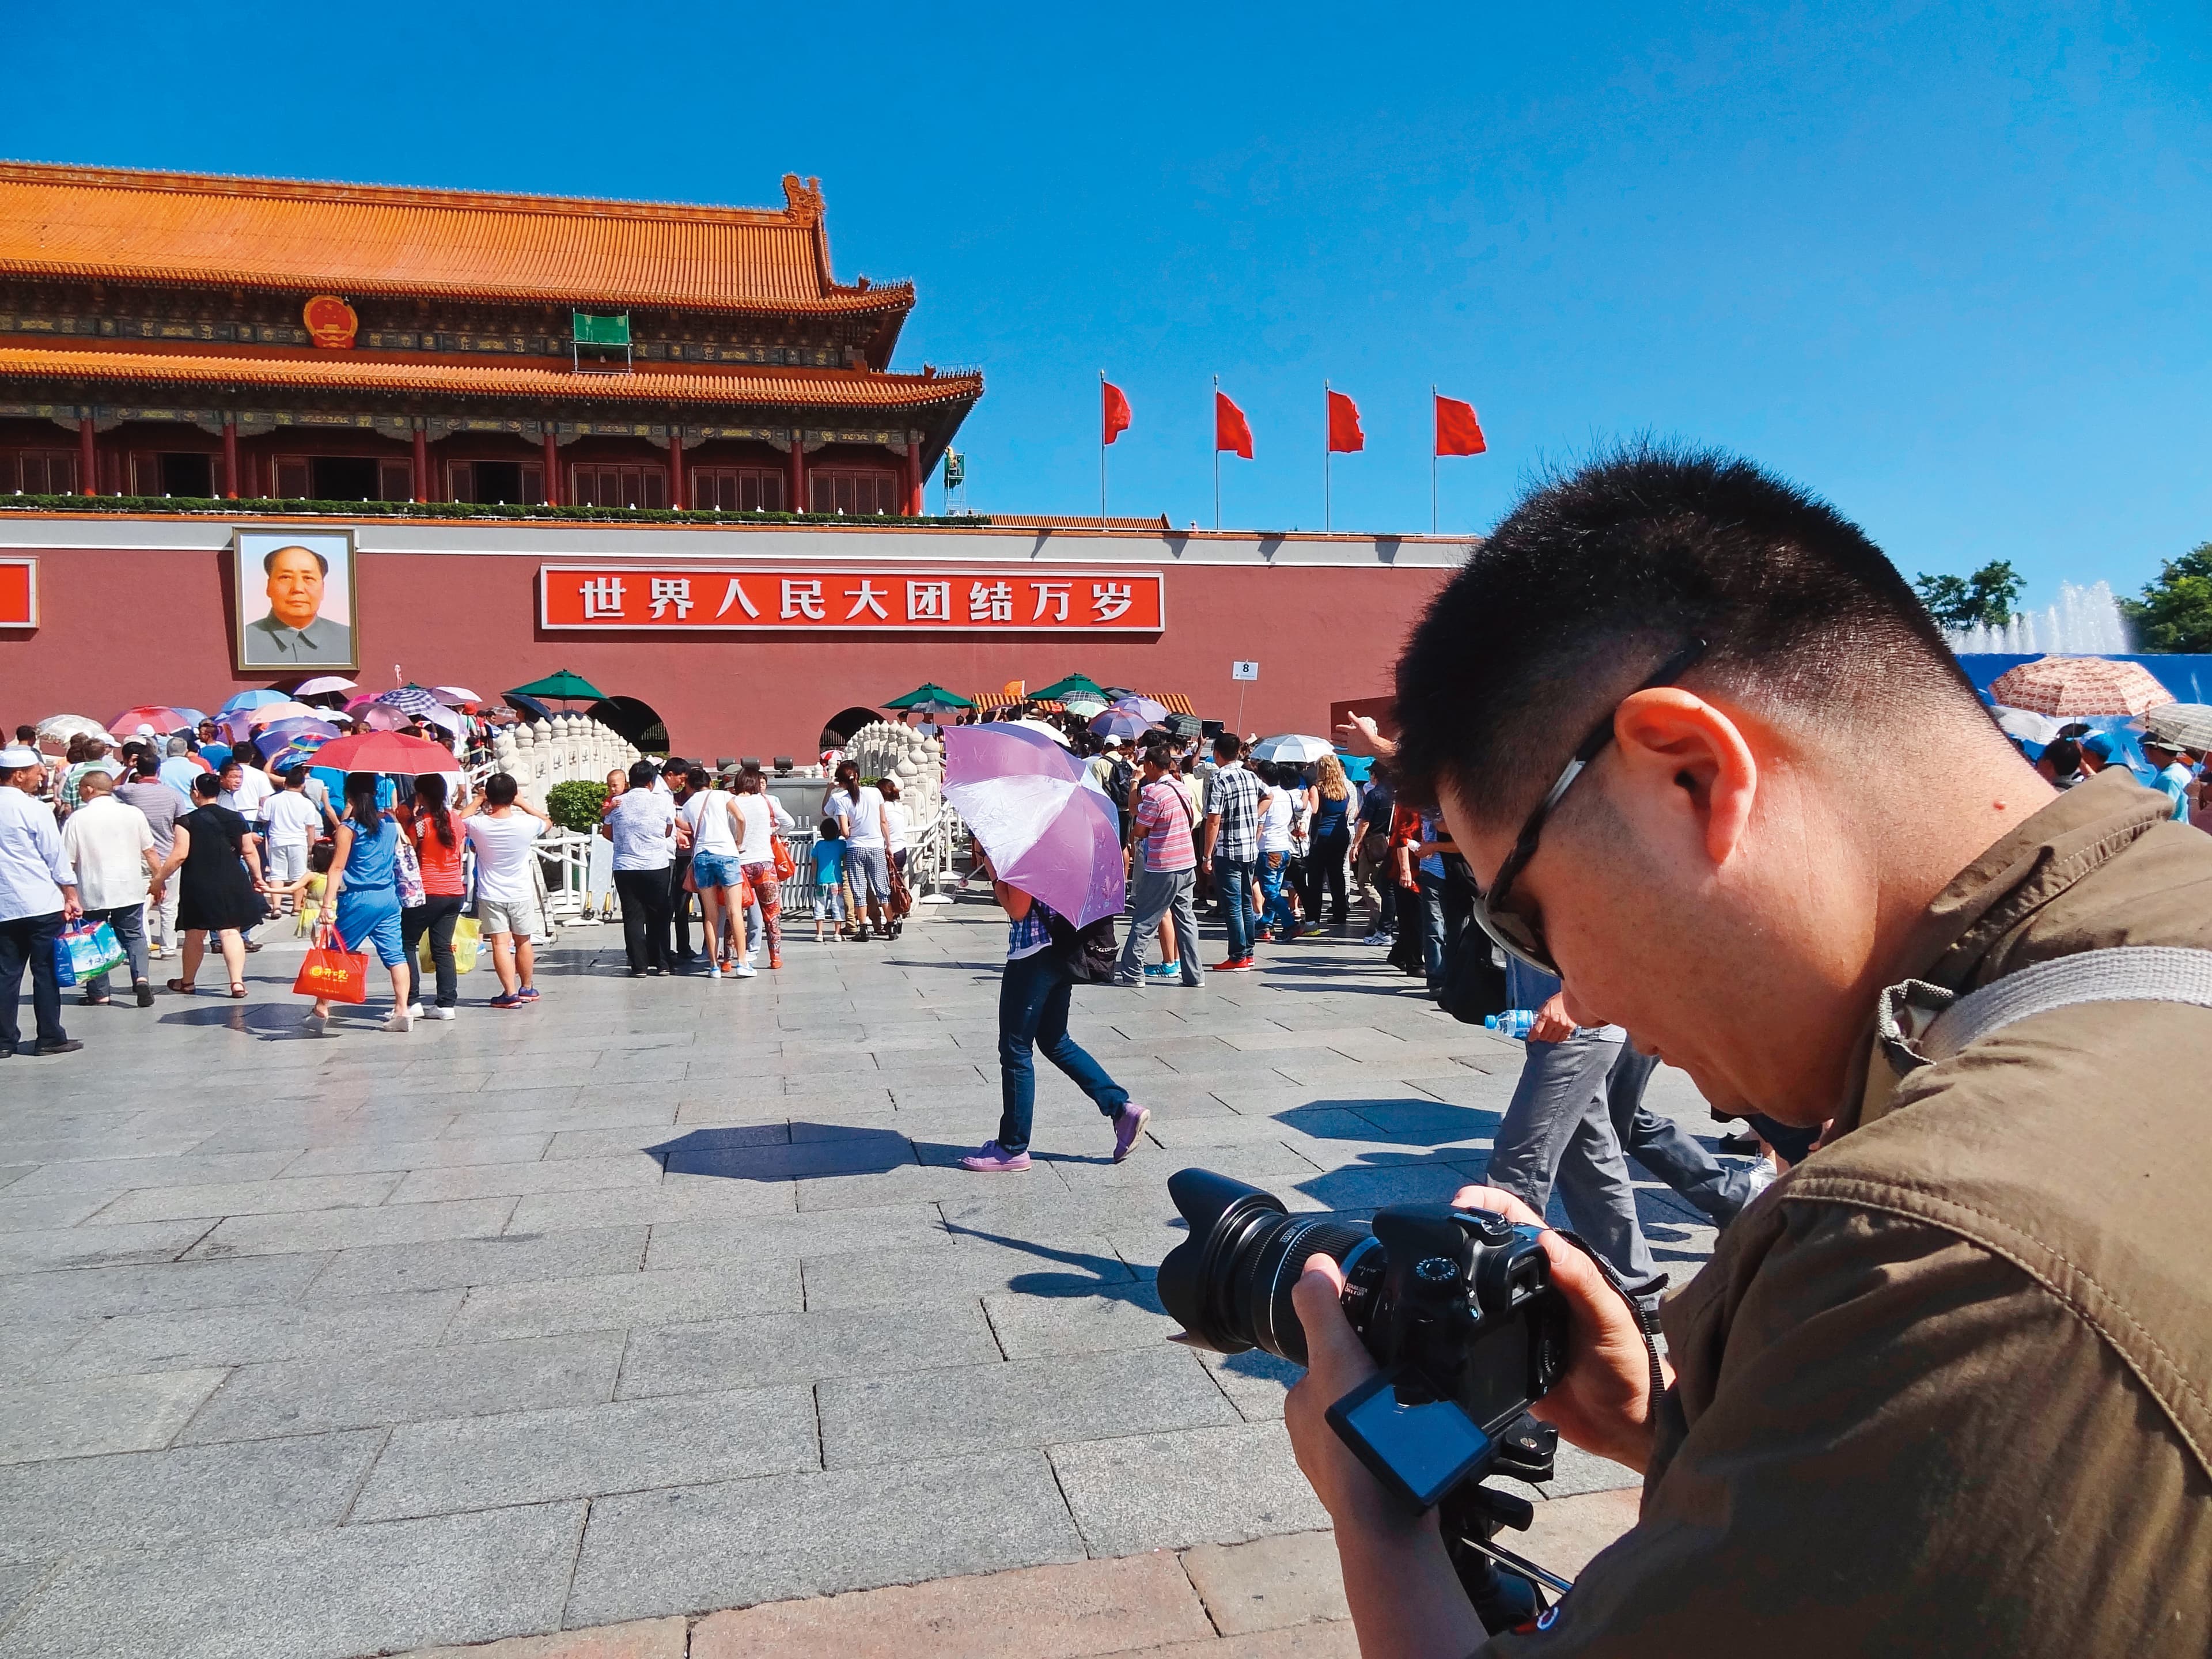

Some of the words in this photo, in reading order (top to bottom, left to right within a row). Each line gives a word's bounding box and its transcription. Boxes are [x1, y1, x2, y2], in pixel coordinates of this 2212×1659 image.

[579, 577, 1132, 621] 世界人民大团结万岁
[1243, 664, 1249, 673] 8
